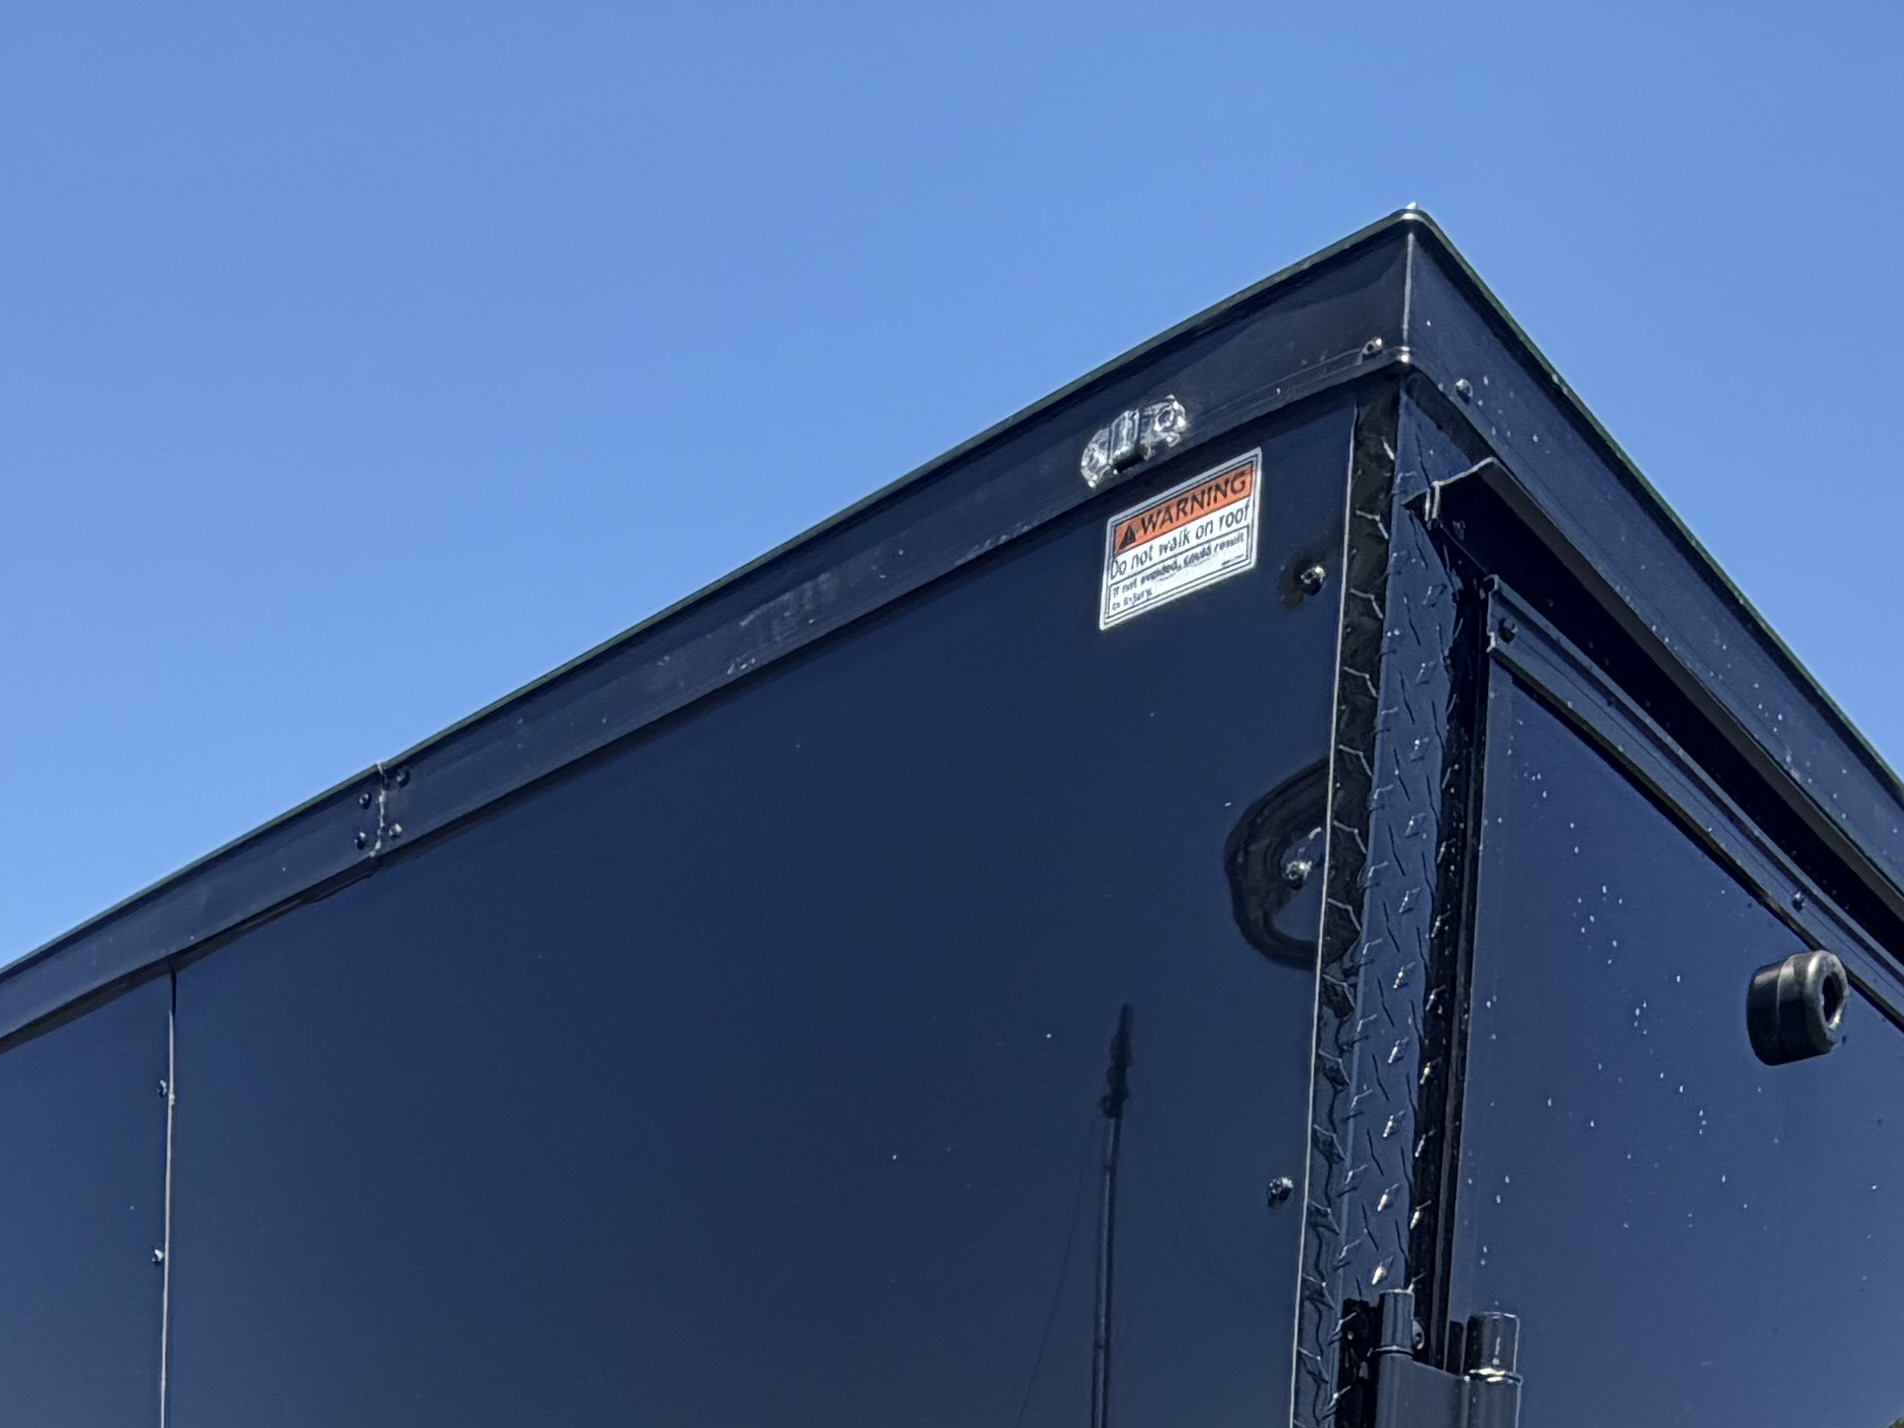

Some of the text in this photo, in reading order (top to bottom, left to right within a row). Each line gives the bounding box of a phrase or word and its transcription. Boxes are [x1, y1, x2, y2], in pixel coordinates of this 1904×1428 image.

[1140, 474, 1246, 536] WARNING
[1110, 501, 1250, 580] Do not walk on roof
